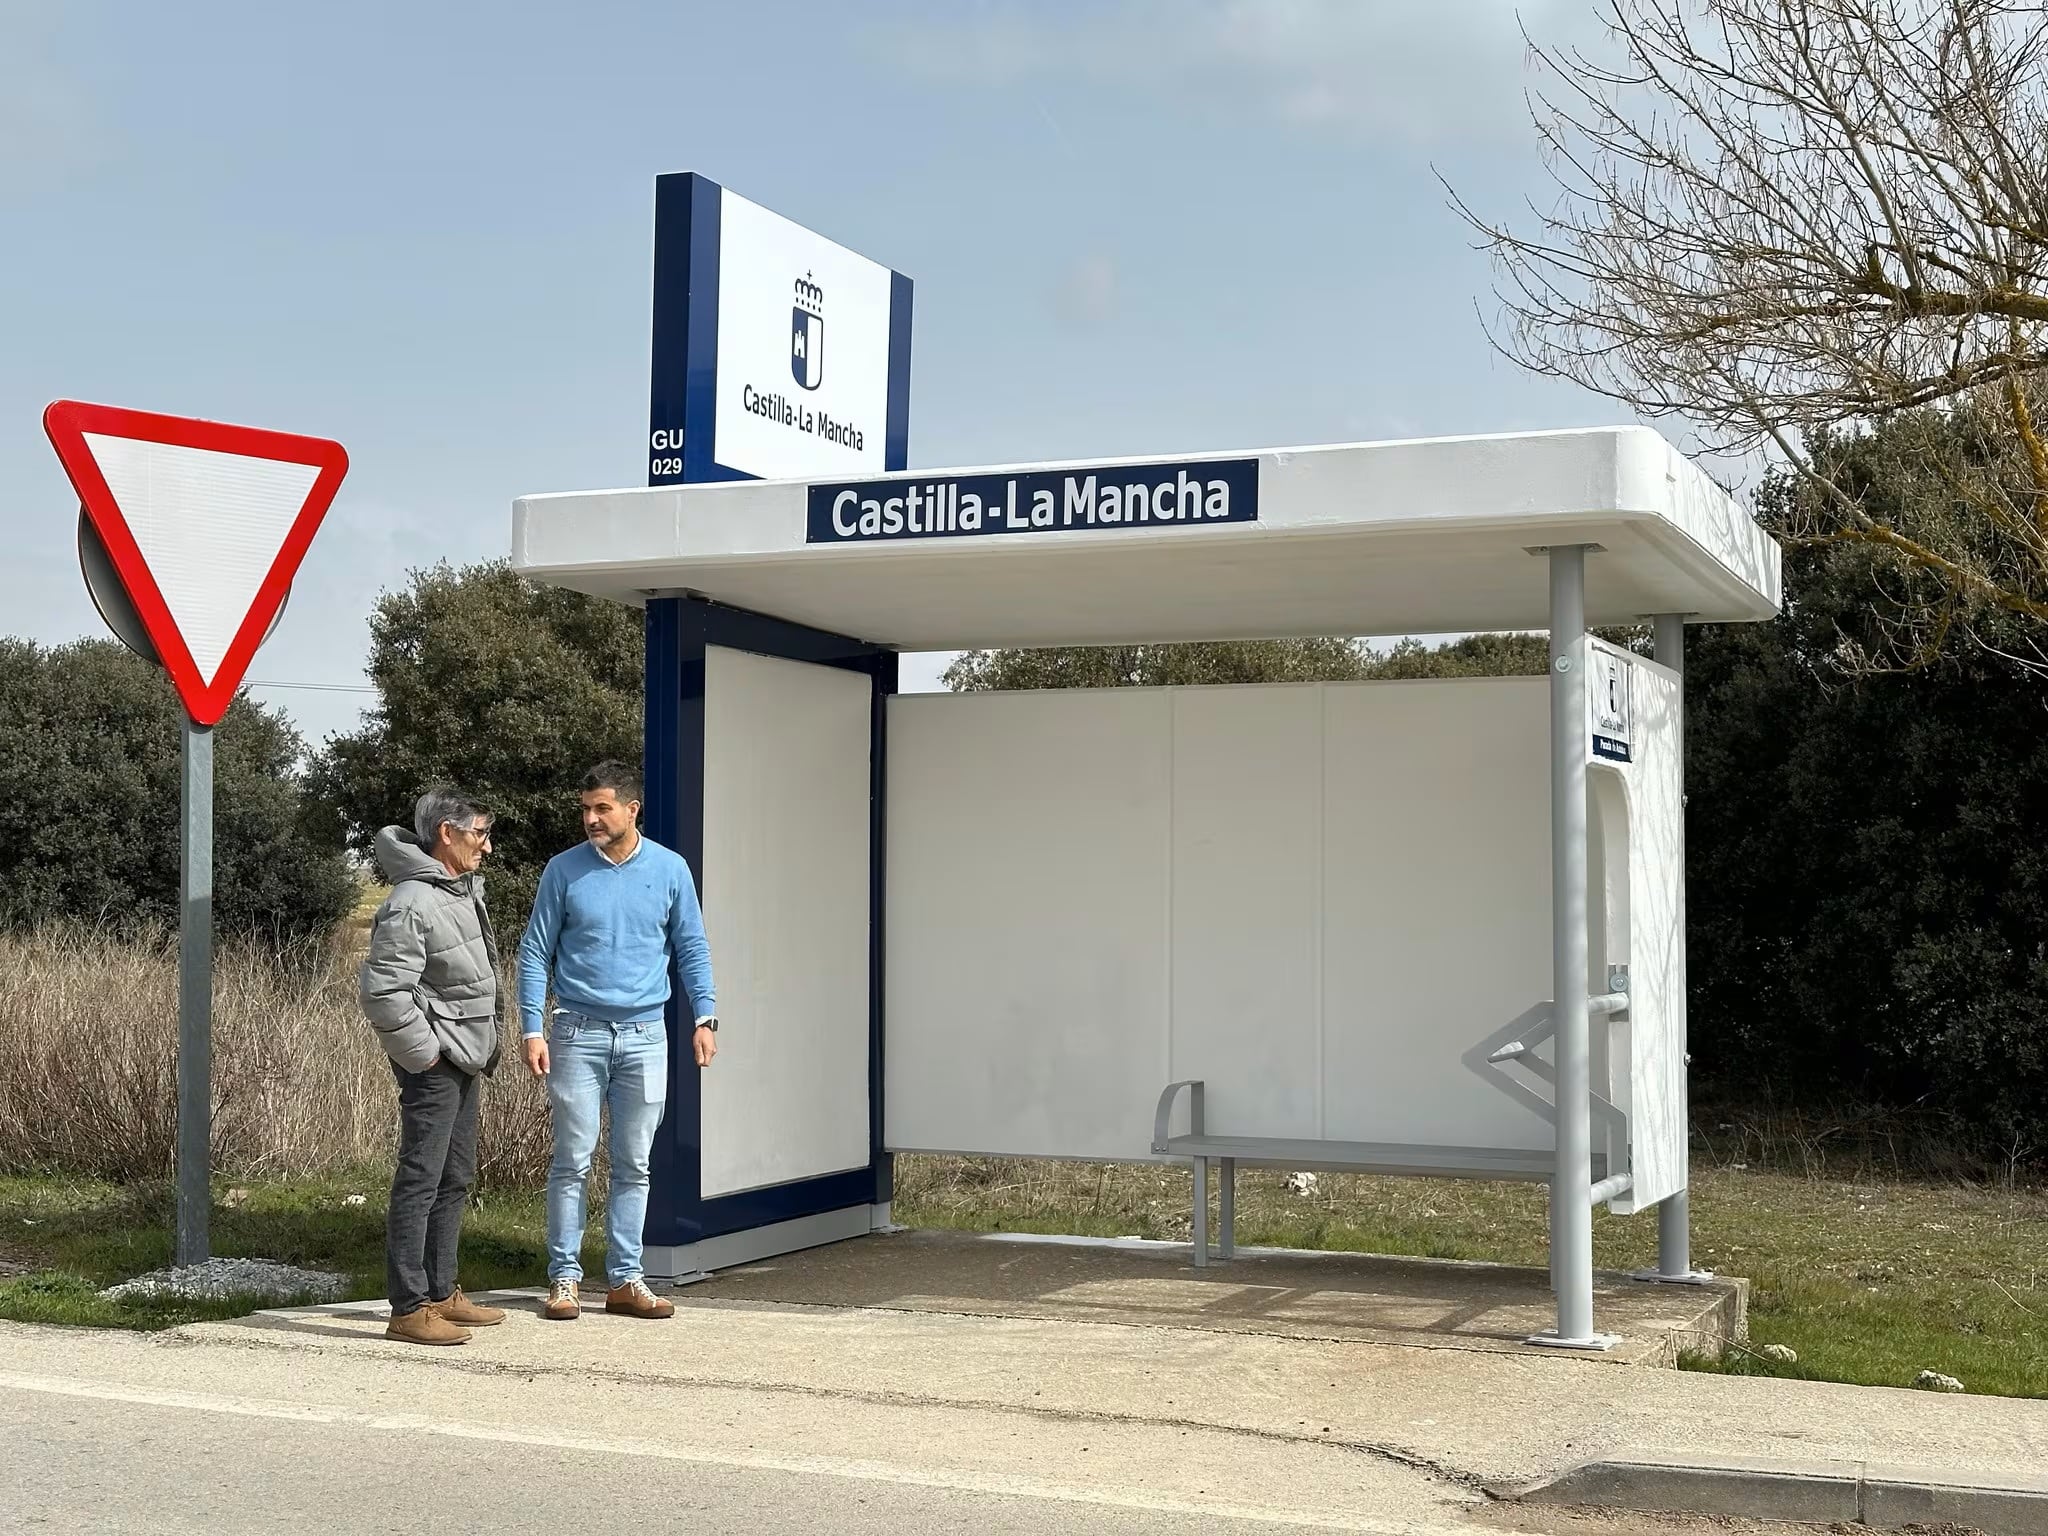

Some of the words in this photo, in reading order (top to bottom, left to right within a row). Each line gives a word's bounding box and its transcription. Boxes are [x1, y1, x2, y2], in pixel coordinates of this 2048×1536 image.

[651, 429, 684, 450] GU
[817, 411, 863, 451] Mancha
[652, 458, 682, 475] 029
[1063, 470, 1230, 525] Mancha
